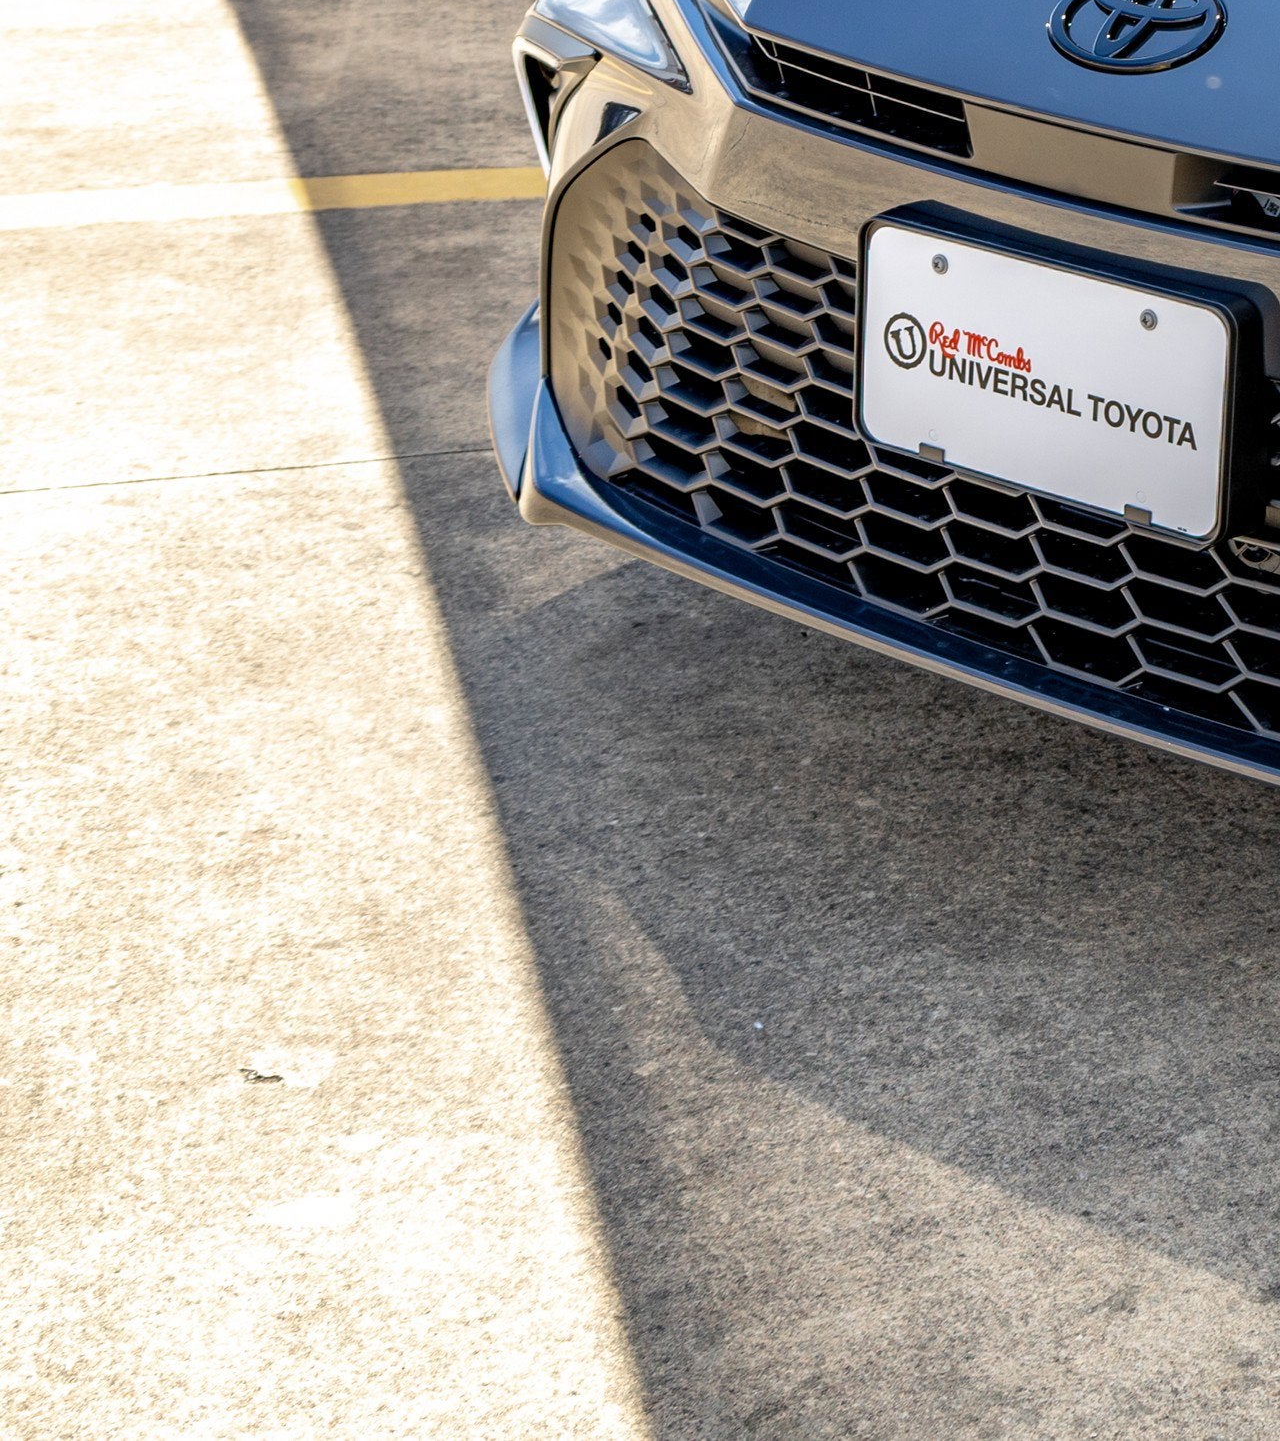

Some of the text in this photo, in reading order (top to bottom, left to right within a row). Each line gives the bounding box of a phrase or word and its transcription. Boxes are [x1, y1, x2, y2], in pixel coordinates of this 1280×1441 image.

[929, 321, 1032, 373] Red McCombs
[929, 349, 1198, 450] UNIVERSAL TOYOTA
